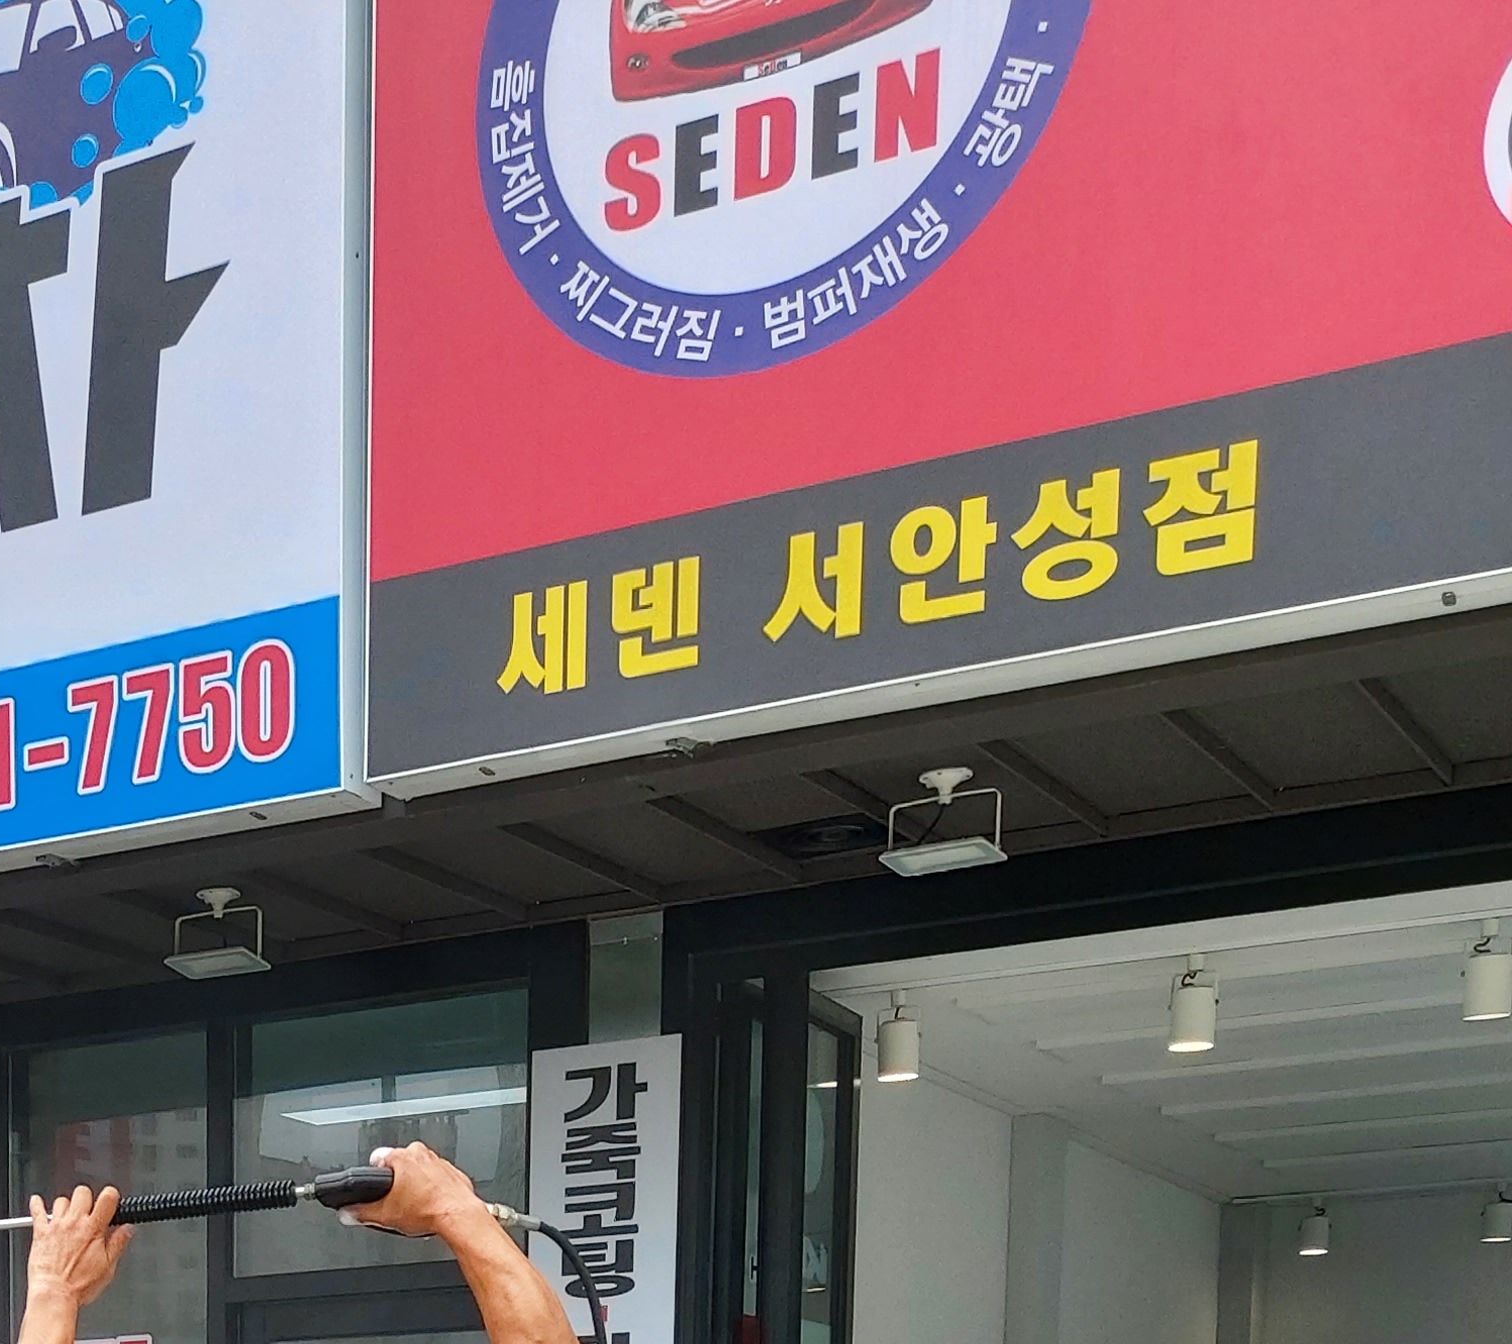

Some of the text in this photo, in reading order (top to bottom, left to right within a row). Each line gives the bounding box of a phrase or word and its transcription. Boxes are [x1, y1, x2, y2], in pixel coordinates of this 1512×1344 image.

[490, 57, 1055, 362] 흠집제거 찌그러짐 범퍼재생 광택
[603, 48, 942, 233] SEDEN
[496, 438, 1259, 695] 세덴 서안성점
[561, 1061, 649, 1299] 가죽코팅
